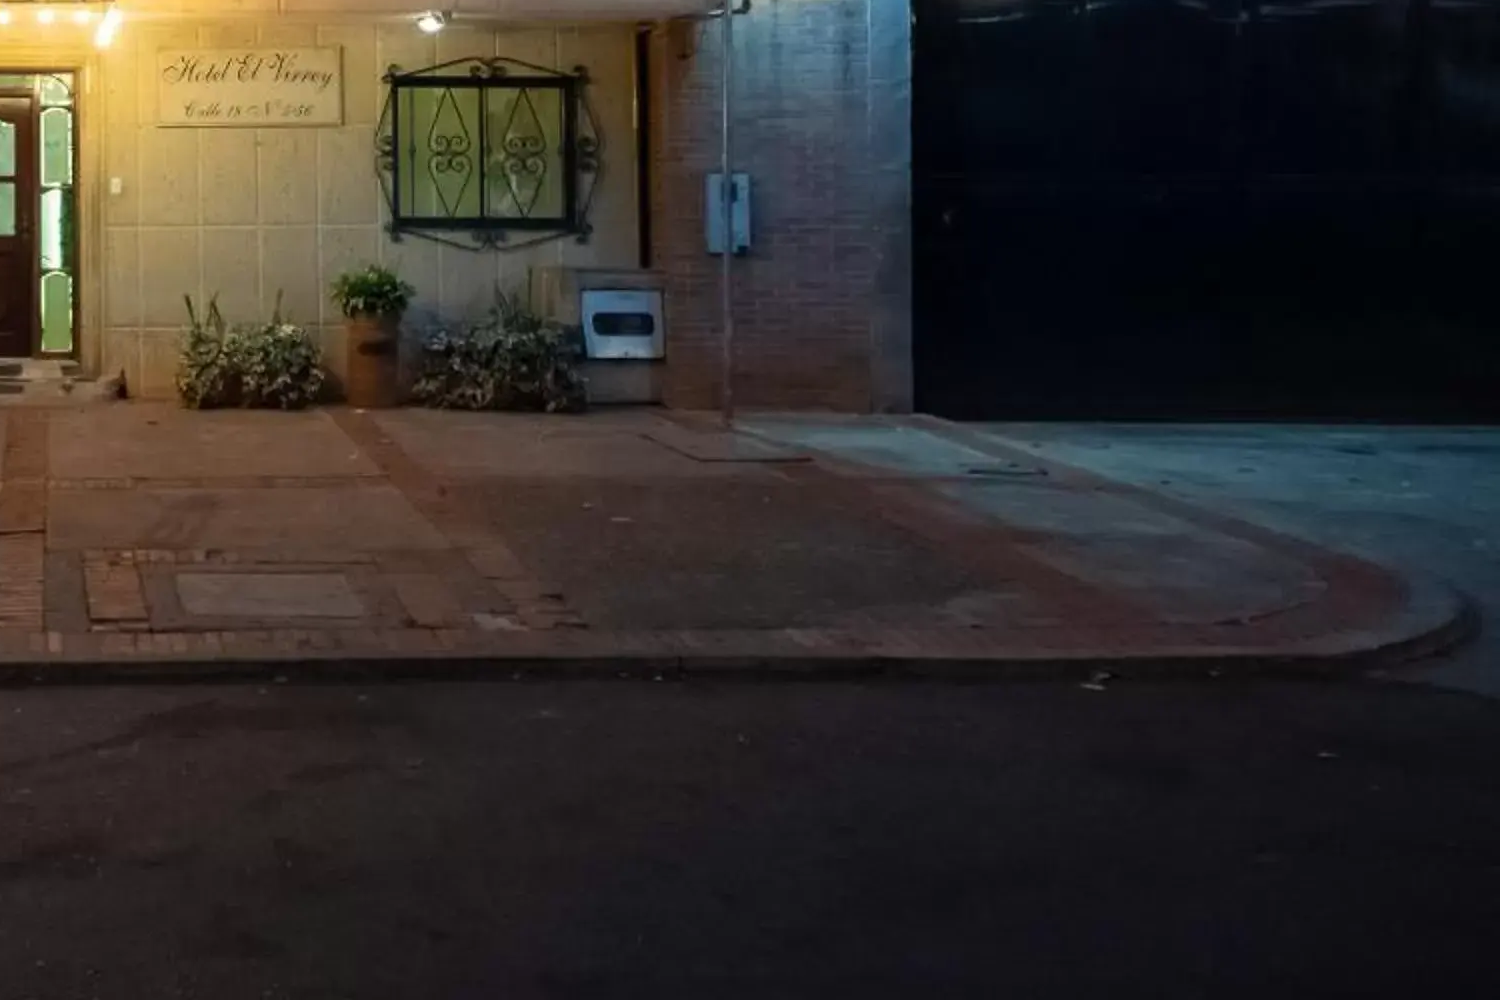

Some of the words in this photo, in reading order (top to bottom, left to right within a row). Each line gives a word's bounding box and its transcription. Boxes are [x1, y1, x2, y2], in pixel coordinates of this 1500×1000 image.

[163, 54, 232, 85] Hotel
[235, 53, 264, 83] El
[267, 52, 334, 92] Virrey
